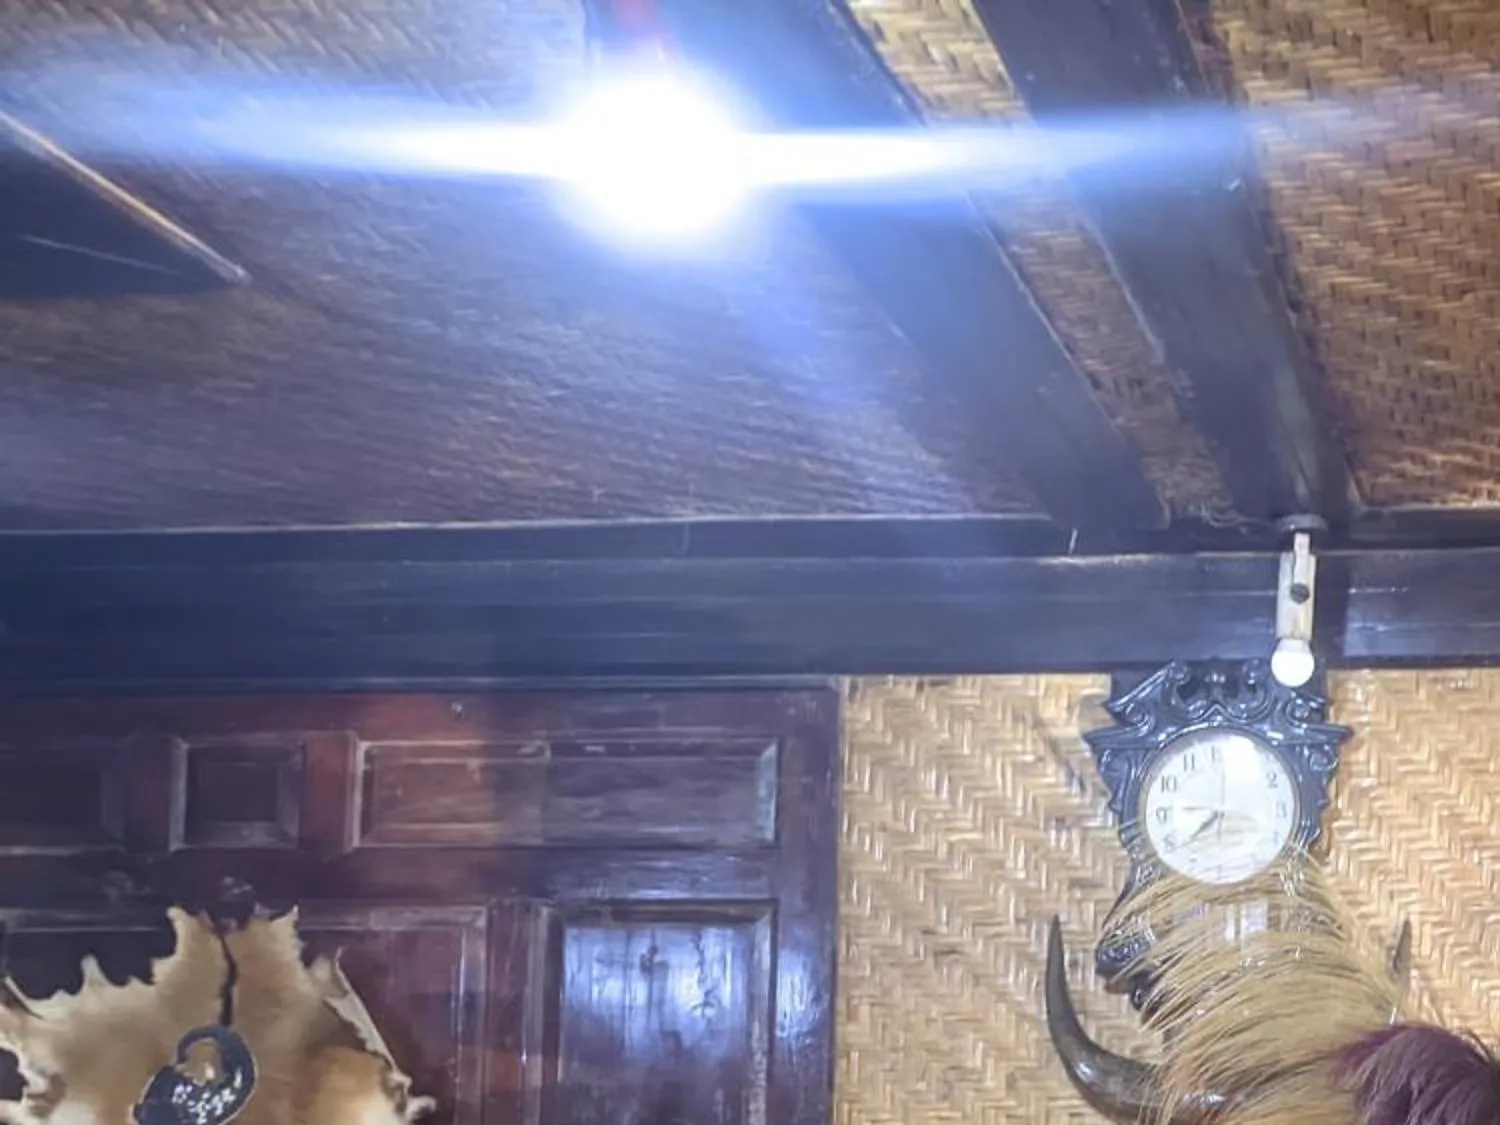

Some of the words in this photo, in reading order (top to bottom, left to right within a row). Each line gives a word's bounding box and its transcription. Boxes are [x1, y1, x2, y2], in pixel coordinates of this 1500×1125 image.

[1183, 753, 1195, 771] 11
[1160, 775, 1177, 794] 10
[1265, 772, 1279, 789] 2
[1155, 806, 1169, 824] 9
